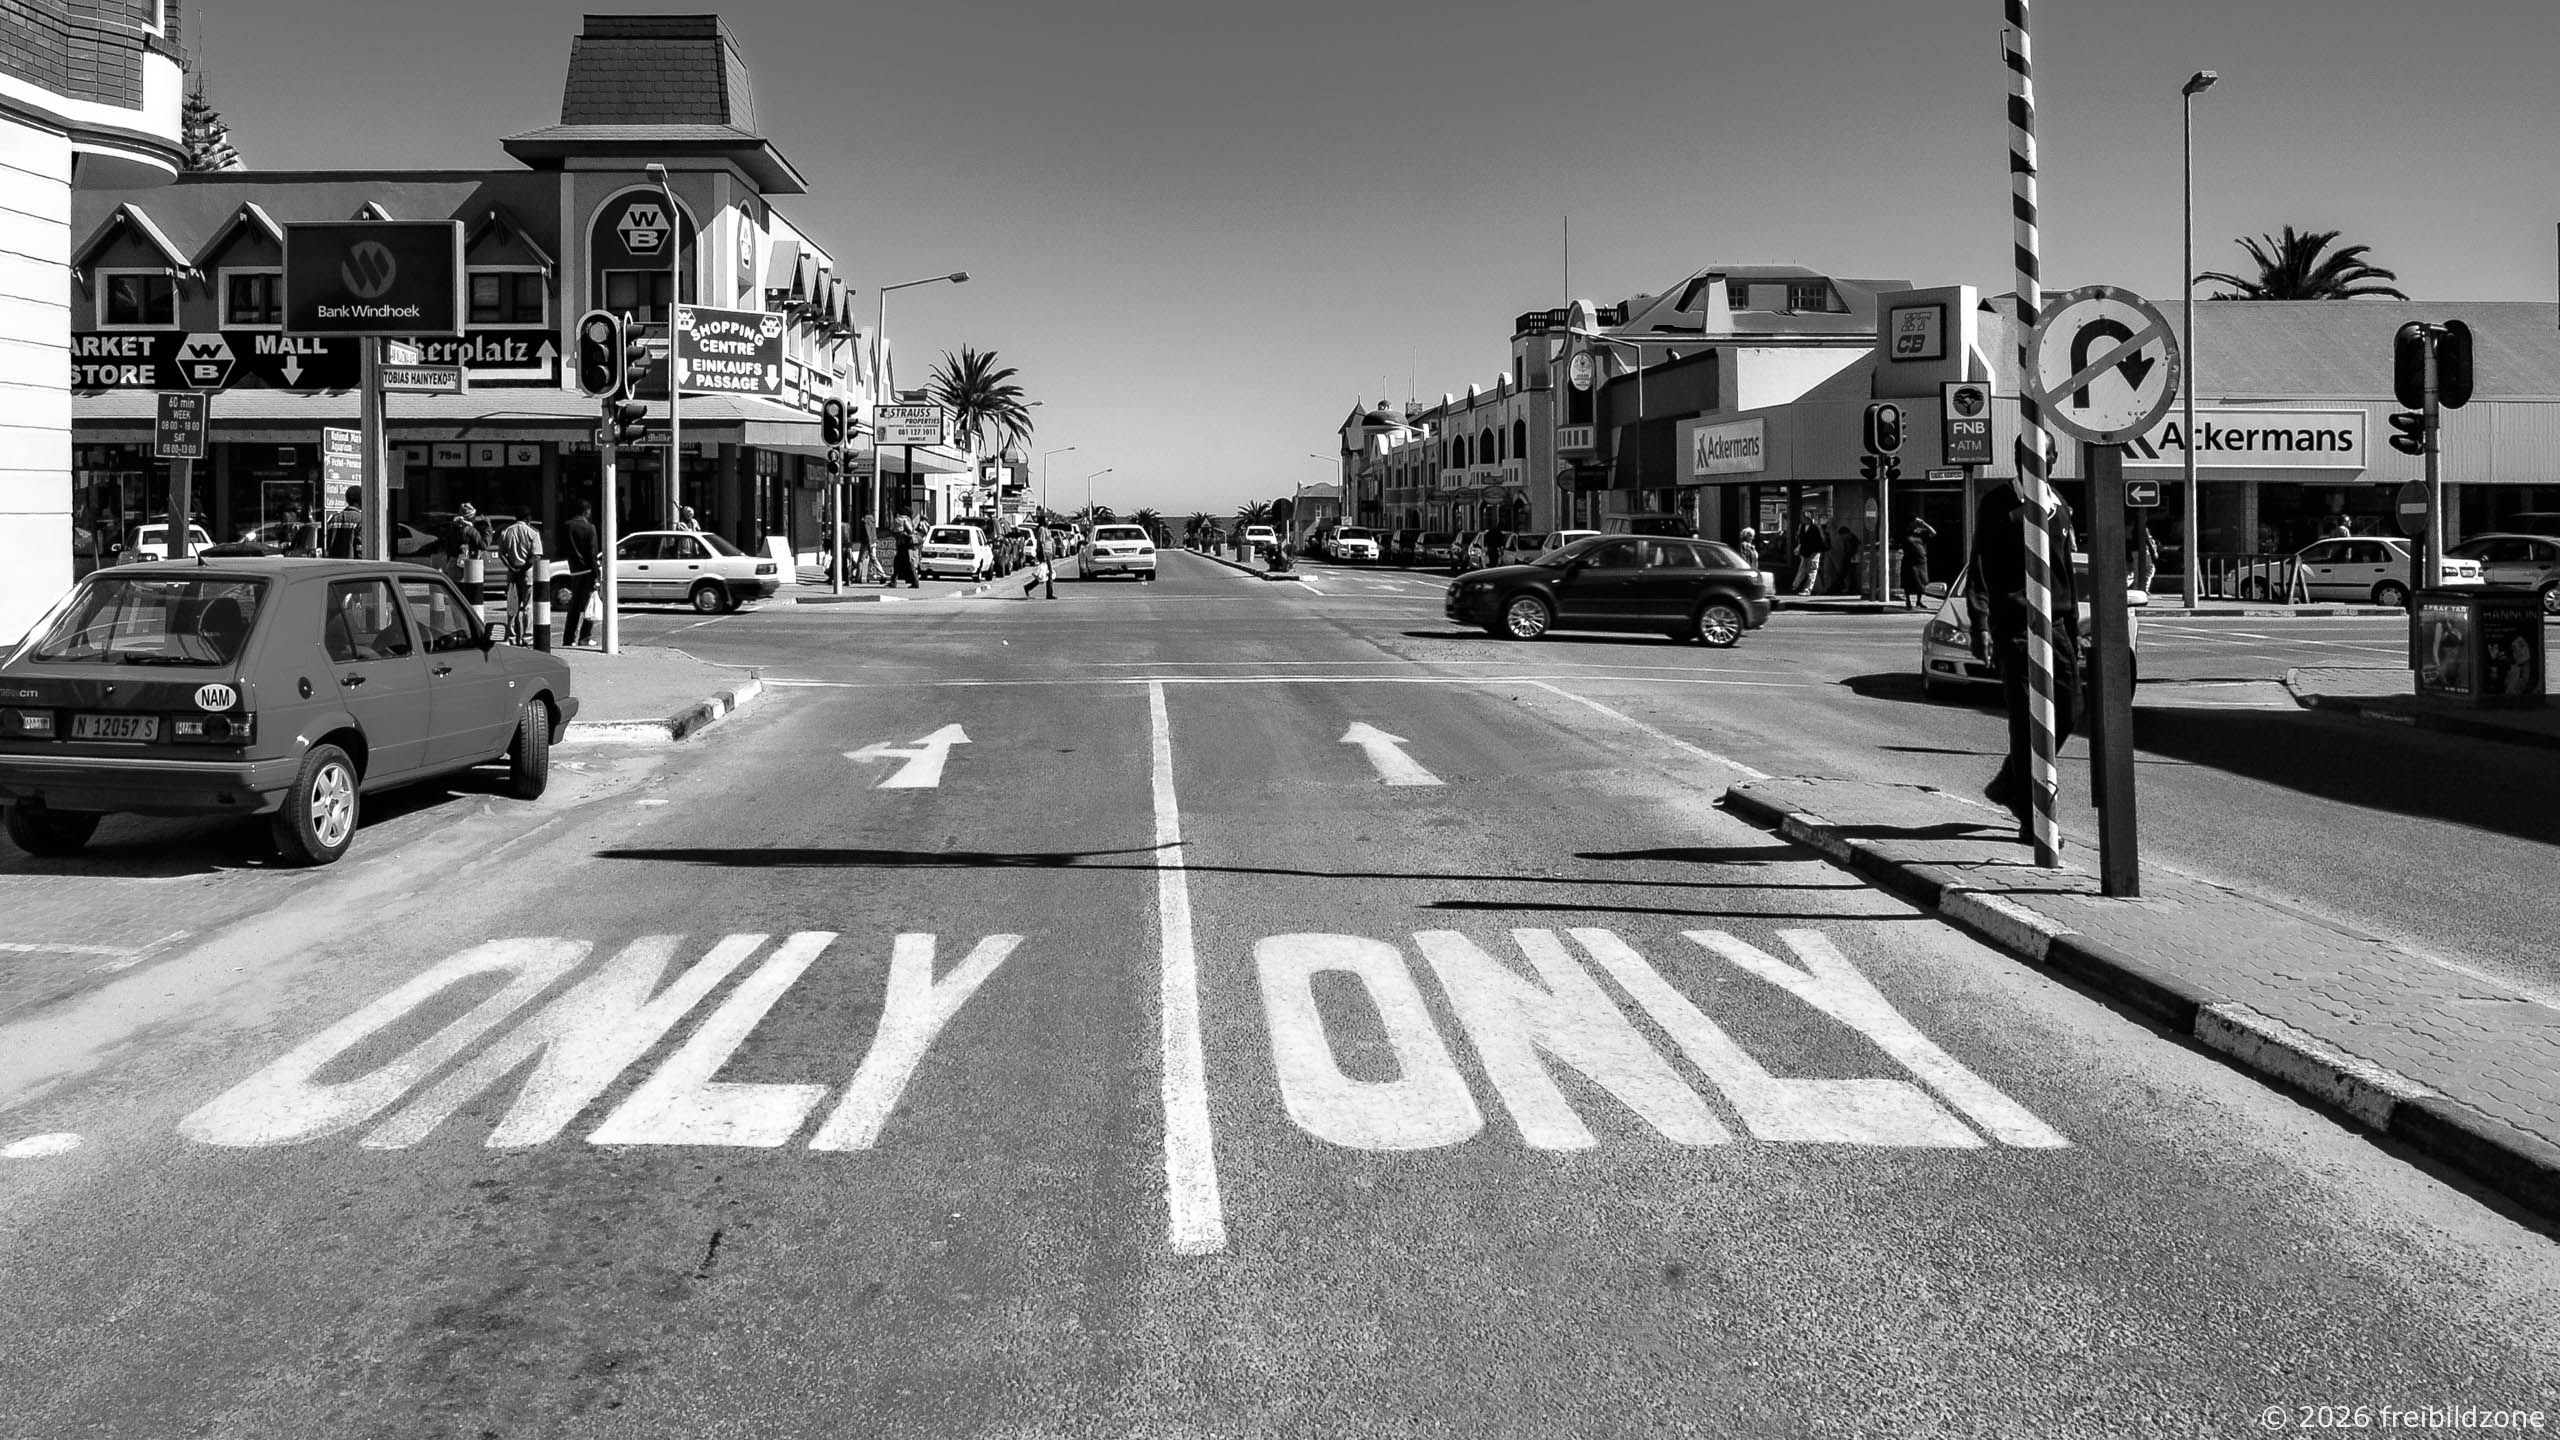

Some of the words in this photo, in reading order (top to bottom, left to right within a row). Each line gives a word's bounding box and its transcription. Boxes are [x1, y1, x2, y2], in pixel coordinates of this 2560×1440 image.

[629, 211, 658, 227] W
[629, 230, 658, 247] B
[318, 305, 350, 318] Bank
[351, 304, 420, 318] Windhoek
[690, 321, 765, 347] SHOPPING
[186, 343, 223, 359] W
[255, 335, 328, 355] MALL
[700, 339, 756, 356] CENTRE
[1897, 334, 1926, 354] CB
[71, 365, 155, 384] STORE
[194, 365, 219, 379] B
[692, 358, 763, 376] EINKAUFS
[383, 371, 410, 385] TOBIAS
[410, 372, 448, 386] HAINYEKO
[696, 374, 759, 391] PASSAGE
[168, 396, 178, 408] 60
[180, 397, 195, 408] min
[173, 409, 191, 420] WEEK
[890, 408, 931, 418] STRAUSS
[910, 428, 921, 436] 127
[1953, 422, 1985, 434] FNB
[174, 432, 186, 442] SAT
[1708, 435, 1760, 461] Ackermans
[1957, 440, 1982, 451] ATM
[19, 689, 39, 698] CITI
[201, 688, 230, 707] NAM
[76, 719, 85, 736] N
[94, 718, 140, 737] 12057
[145, 720, 153, 737] S
[178, 931, 1025, 1152] ONLY
[1253, 928, 2074, 1152] ONLY
